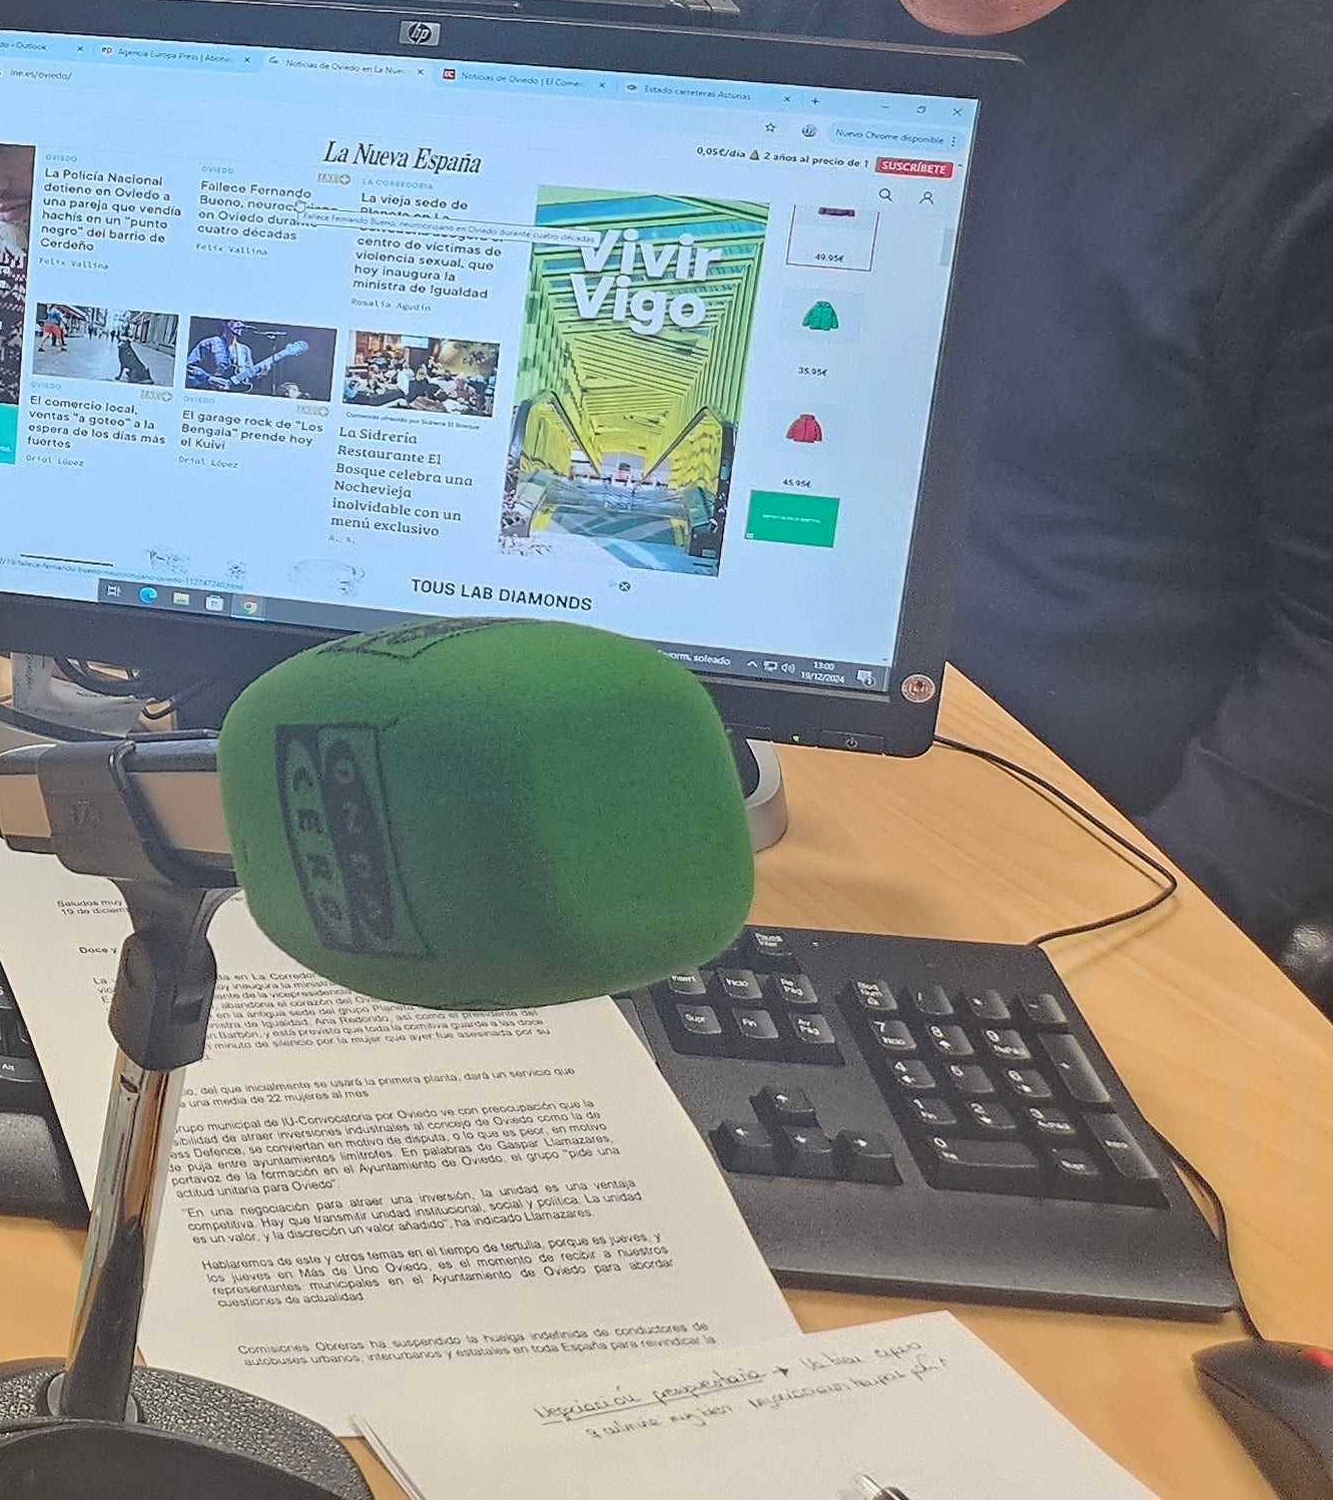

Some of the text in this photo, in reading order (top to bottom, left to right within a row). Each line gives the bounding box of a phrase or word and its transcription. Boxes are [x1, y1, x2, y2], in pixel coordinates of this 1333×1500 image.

[407, 21, 432, 45] hp
[323, 140, 482, 175] La Nueva España
[763, 151, 771, 160] 2
[773, 154, 797, 162] años
[799, 155, 810, 163] al
[811, 157, 845, 166] precio
[847, 158, 861, 167] de
[881, 160, 947, 174] SUSCRÍBETE
[45, 167, 163, 186] La Policía Nacional
[43, 182, 170, 201] detiene en Oviedo a
[43, 197, 181, 217] una pareja que vendía
[86, 215, 102, 224] en
[105, 217, 121, 226] un
[40, 237, 94, 251] Cerdeño
[86, 227, 106, 238] del
[109, 229, 146, 242] barrio
[149, 232, 165, 243] de
[569, 273, 707, 336] Vigo
[339, 426, 417, 445] La Sidrería
[337, 444, 441, 466] Restaurante El
[335, 462, 473, 487] Bosque celebra una
[334, 480, 412, 500] Nochevieja
[332, 497, 461, 521] inolvidable con un
[331, 517, 440, 537] menú exclusivo
[411, 578, 592, 611] TOUS LAB DIAMONDS
[693, 654, 731, 666] soleado
[814, 661, 835, 671] 13:00
[801, 671, 845, 683] 19/12/2024
[894, 1061, 907, 1072] 4
[210, 1208, 234, 1217] una
[240, 1202, 311, 1215] negociación
[315, 1200, 343, 1211] para
[349, 1197, 383, 1208] atraer
[390, 1195, 414, 1205] una
[480, 1188, 493, 1198] la
[498, 1184, 539, 1196] unidad
[544, 1184, 560, 1193] es
[565, 1182, 588, 1192] una
[593, 1180, 636, 1191] ventaja
[260, 1217, 284, 1228] Hay
[288, 1216, 311, 1227] que
[313, 1211, 367, 1224] transmitir
[370, 1207, 412, 1220] unidad
[489, 1199, 523, 1211] social
[525, 1200, 533, 1210] y
[583, 1194, 601, 1204] La
[602, 1191, 643, 1203] unidad
[212, 1259, 673, 1297] representantes municipales en el Ayuntamiento de Oviedo para abordar
[217, 1291, 365, 1308] cuestiones de actualidad
